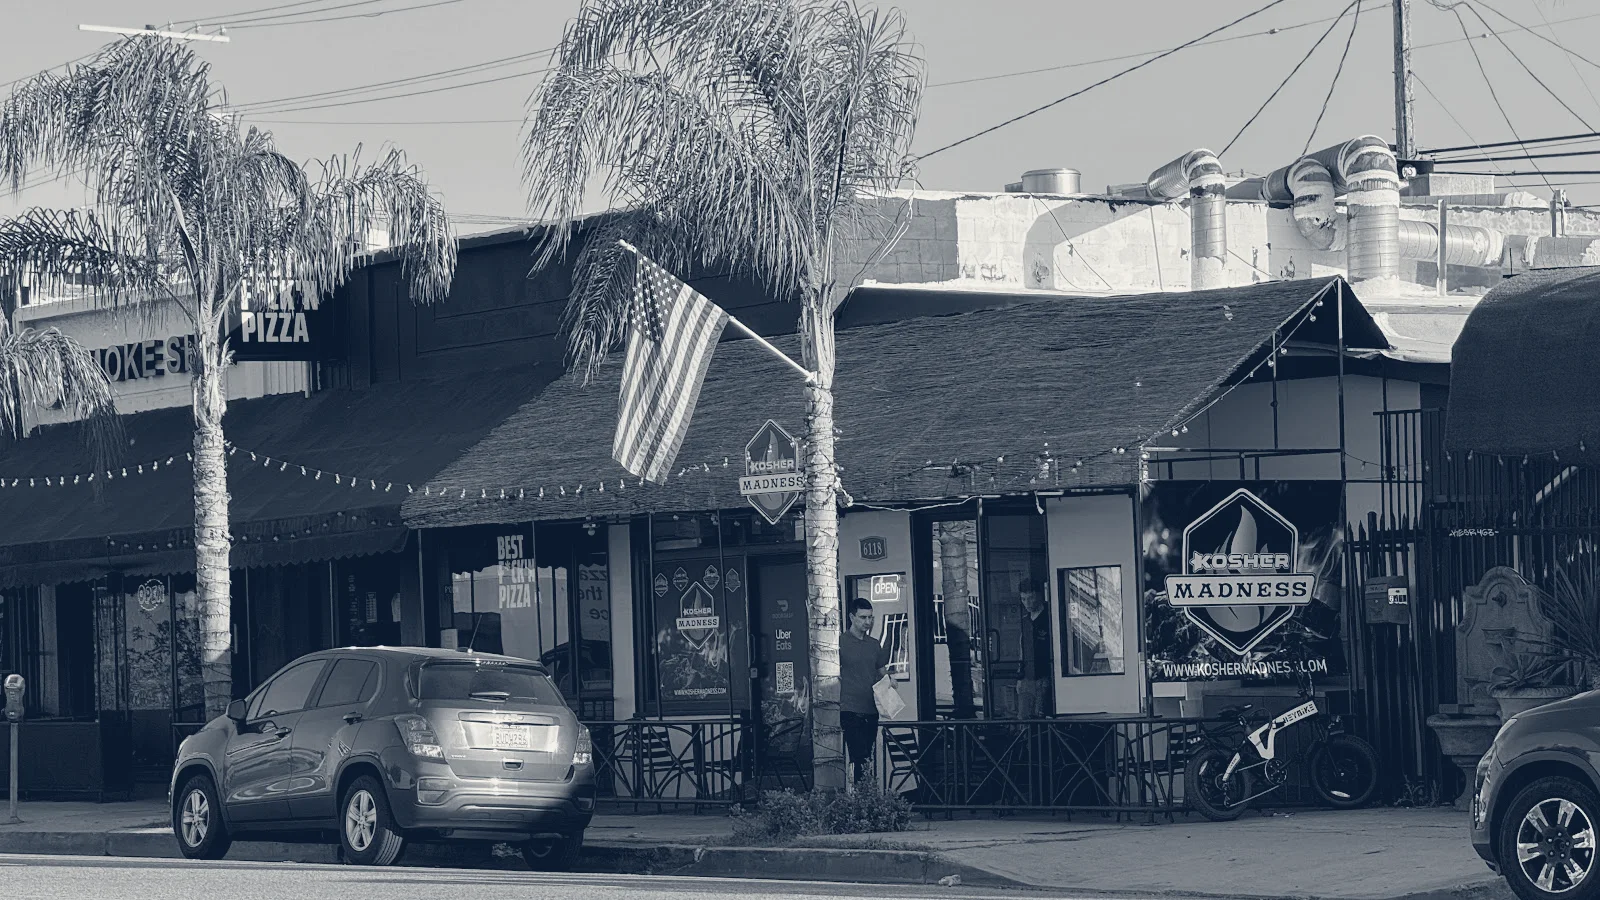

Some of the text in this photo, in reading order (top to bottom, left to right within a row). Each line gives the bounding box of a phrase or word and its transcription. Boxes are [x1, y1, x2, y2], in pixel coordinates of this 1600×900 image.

[241, 280, 319, 310] FCK'N
[241, 312, 310, 342] PIZZA
[95, 340, 156, 382] OKE
[749, 459, 795, 473] KOSHER
[742, 476, 804, 491] MADNESS
[497, 534, 524, 560] BEST
[863, 542, 883, 556] 6118
[1189, 552, 1290, 573] KOSHER
[498, 583, 531, 609] PIZZA
[875, 582, 898, 594] OPEN
[1173, 581, 1308, 599] MADNESS
[682, 607, 712, 616] KOSHER
[678, 619, 718, 628] MADNESS
[775, 629, 792, 640] Uber
[775, 640, 792, 651] Eats
[1163, 658, 1328, 677] WWW.KOSHERMADNES.COM
